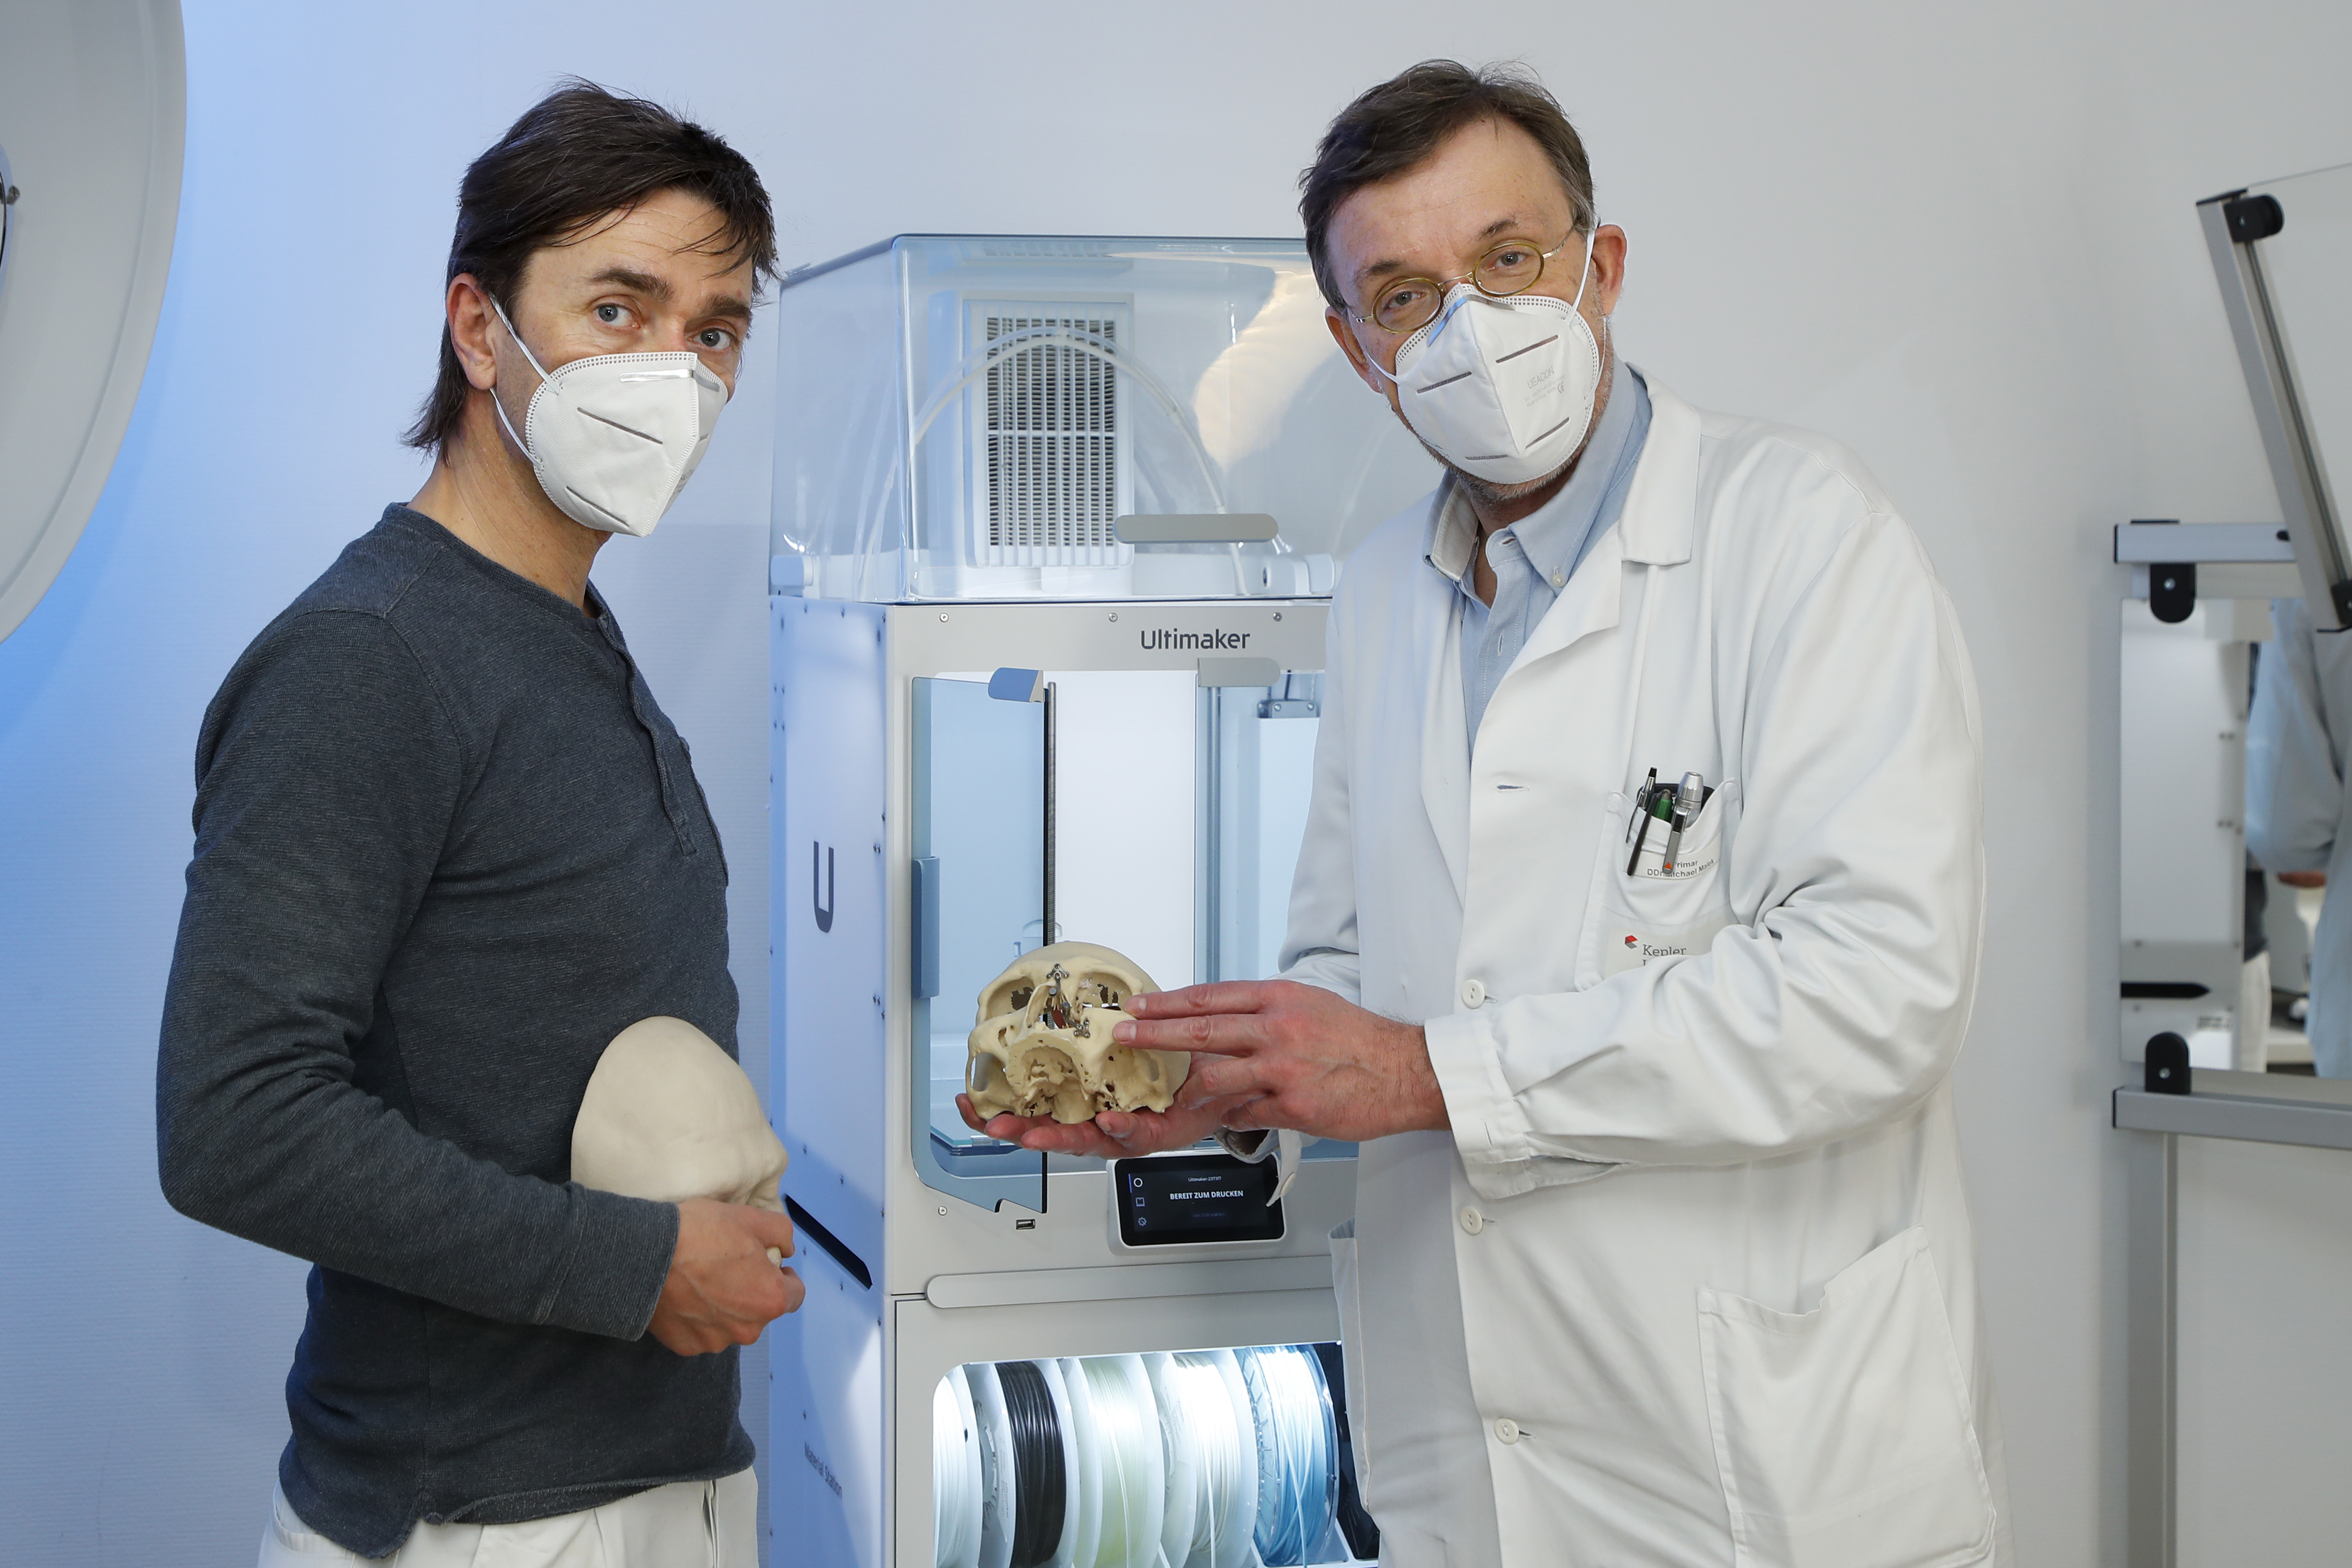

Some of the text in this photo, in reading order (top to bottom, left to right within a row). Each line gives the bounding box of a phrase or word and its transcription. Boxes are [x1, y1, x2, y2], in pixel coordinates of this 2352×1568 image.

[1141, 628, 1251, 650] Ultimaker
[1666, 868, 1697, 878] ichael
[1642, 944, 1687, 957] Kepler
